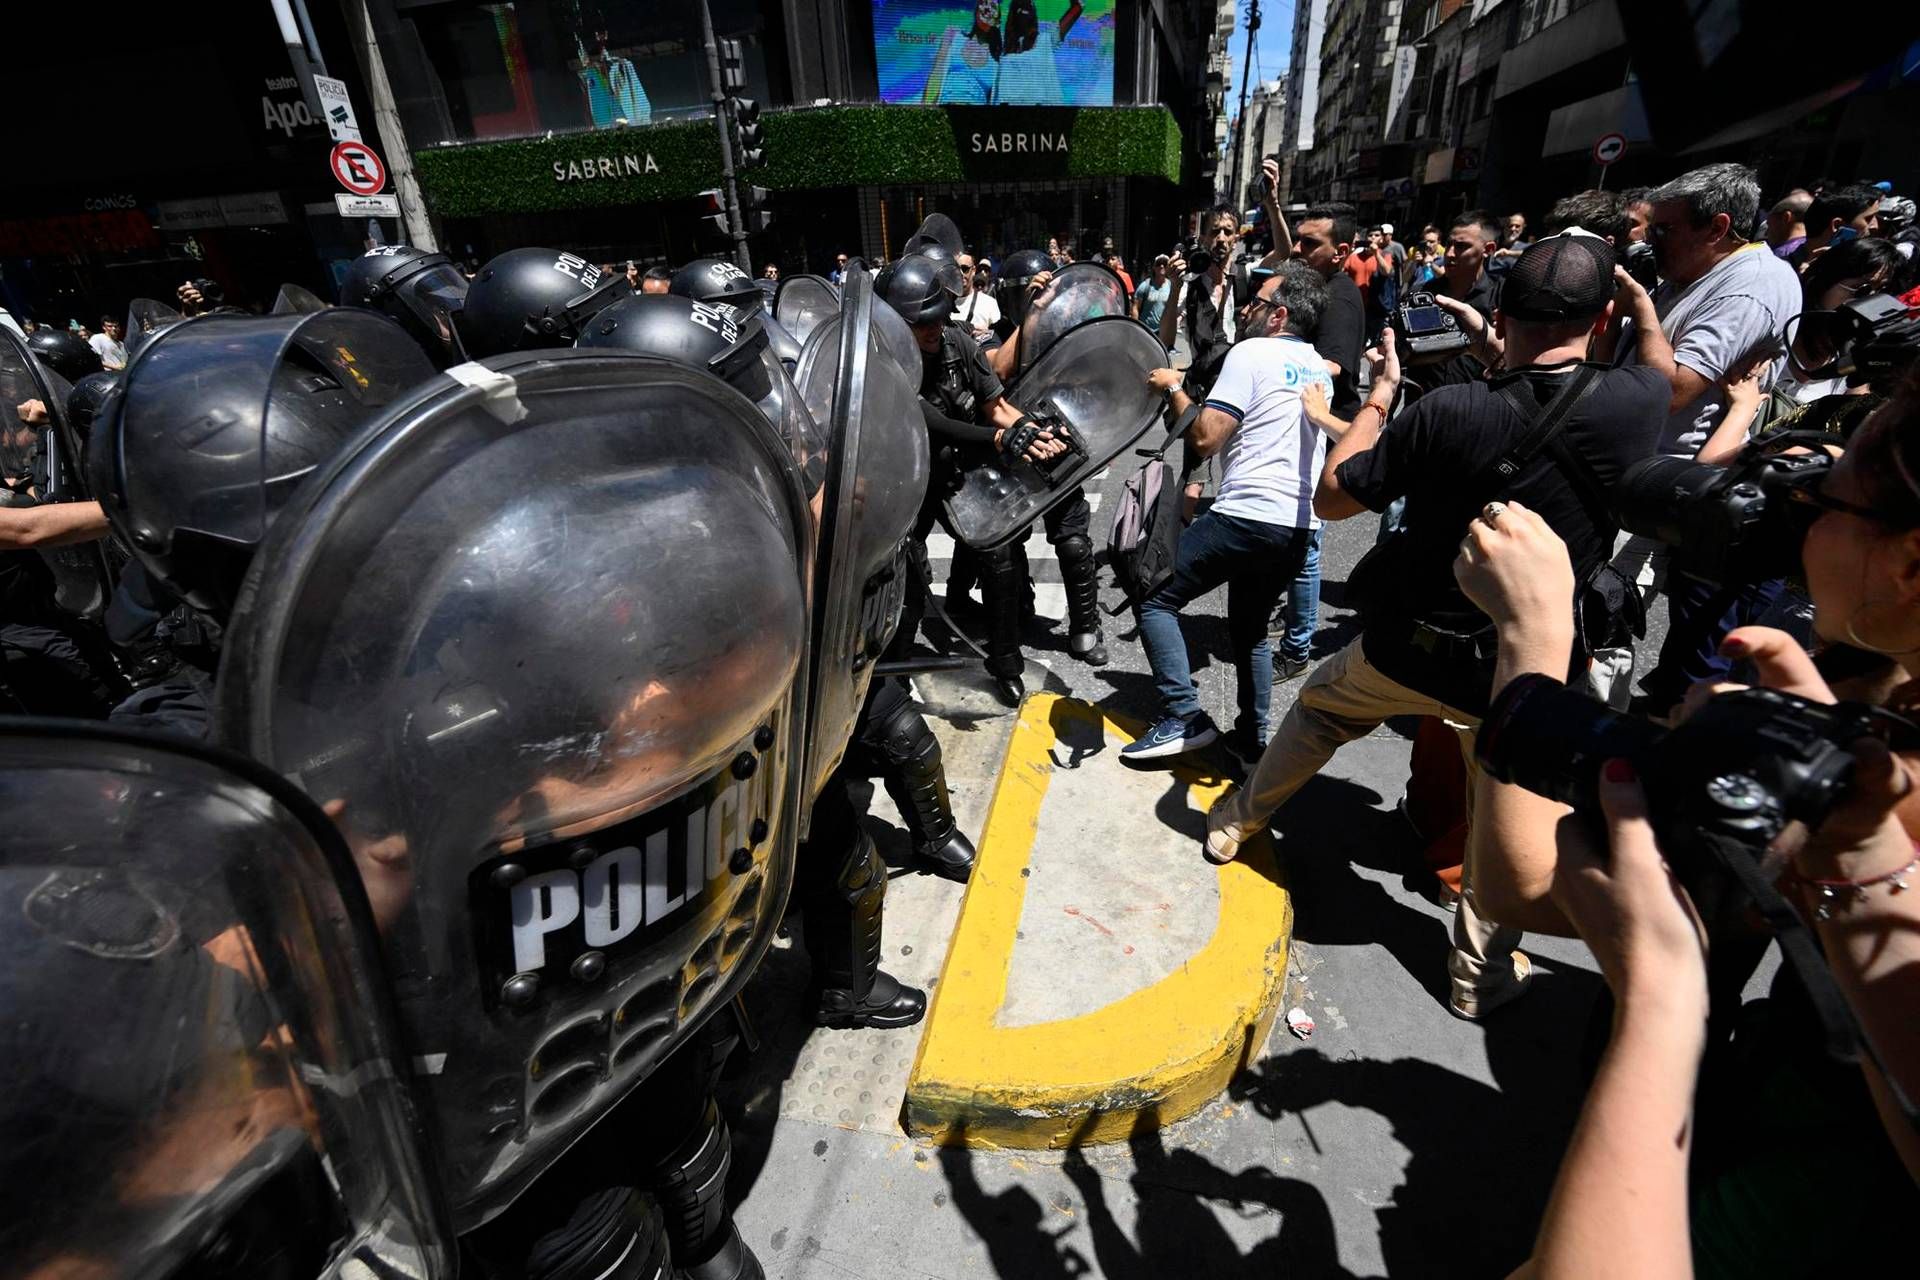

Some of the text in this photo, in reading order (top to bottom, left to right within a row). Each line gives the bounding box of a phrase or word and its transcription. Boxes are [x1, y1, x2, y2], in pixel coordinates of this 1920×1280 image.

[265, 76, 298, 91] teatro
[972, 133, 1068, 152] SABRINA
[553, 153, 659, 181] SABRINA
